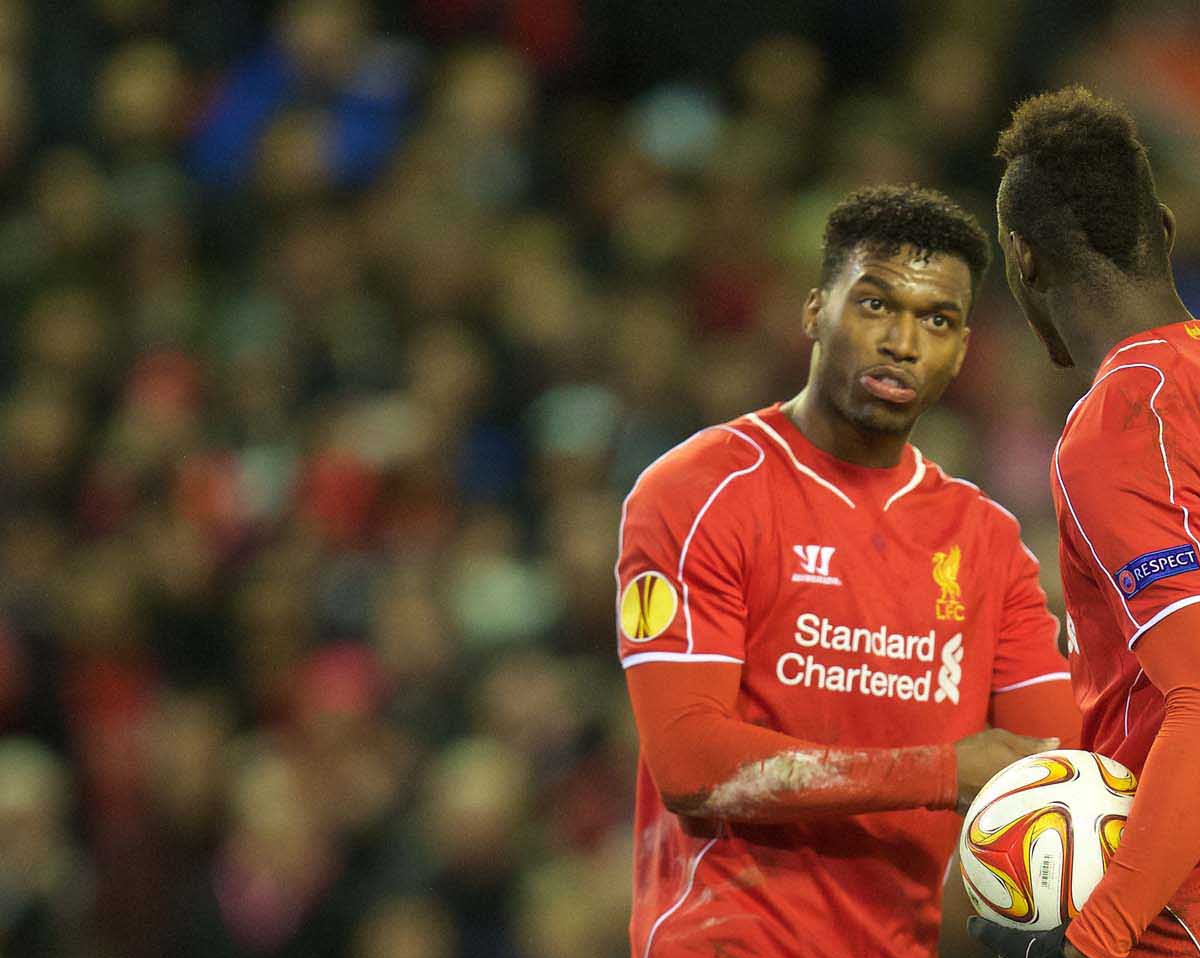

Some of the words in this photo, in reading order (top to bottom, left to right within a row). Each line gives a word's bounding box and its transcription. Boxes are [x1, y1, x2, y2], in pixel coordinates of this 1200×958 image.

[1133, 550, 1195, 581] RESPECT
[795, 613, 936, 662] Standard
[776, 653, 932, 702] Chartered
